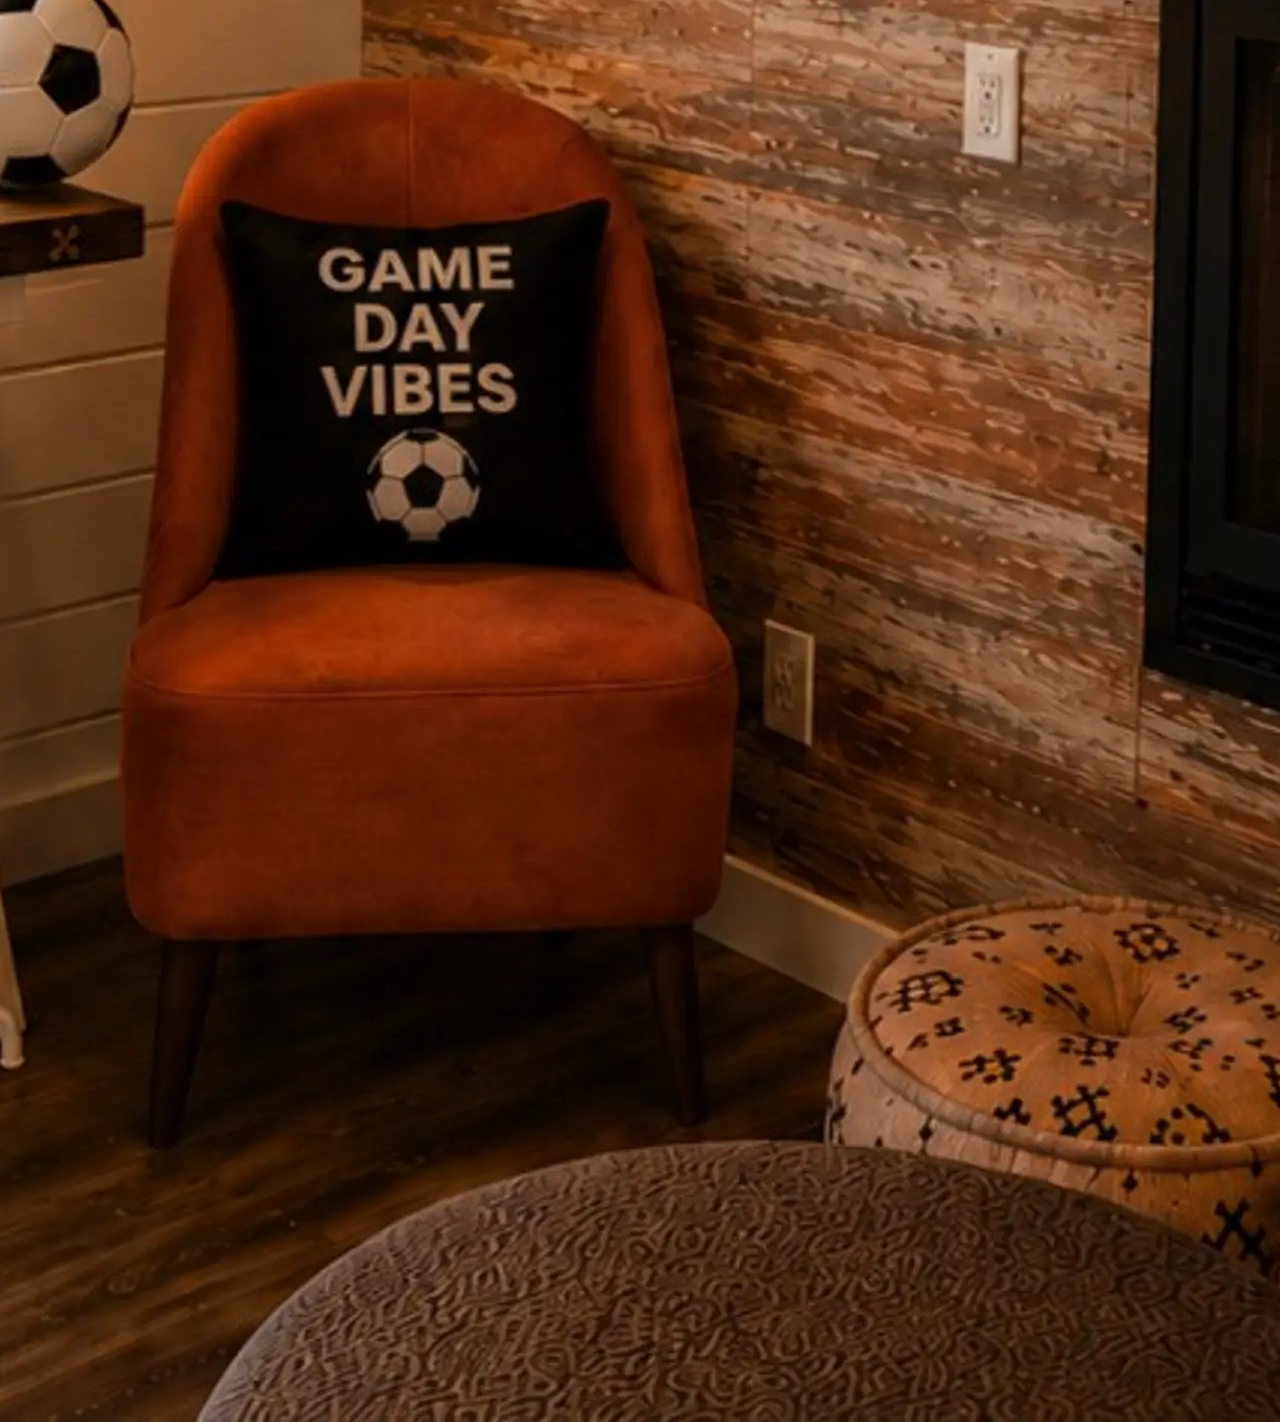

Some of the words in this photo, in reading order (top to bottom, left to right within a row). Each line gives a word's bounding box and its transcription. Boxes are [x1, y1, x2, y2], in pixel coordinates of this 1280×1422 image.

[320, 245, 515, 293] GAME
[355, 302, 486, 353] DAY
[322, 363, 518, 417] VIBES
